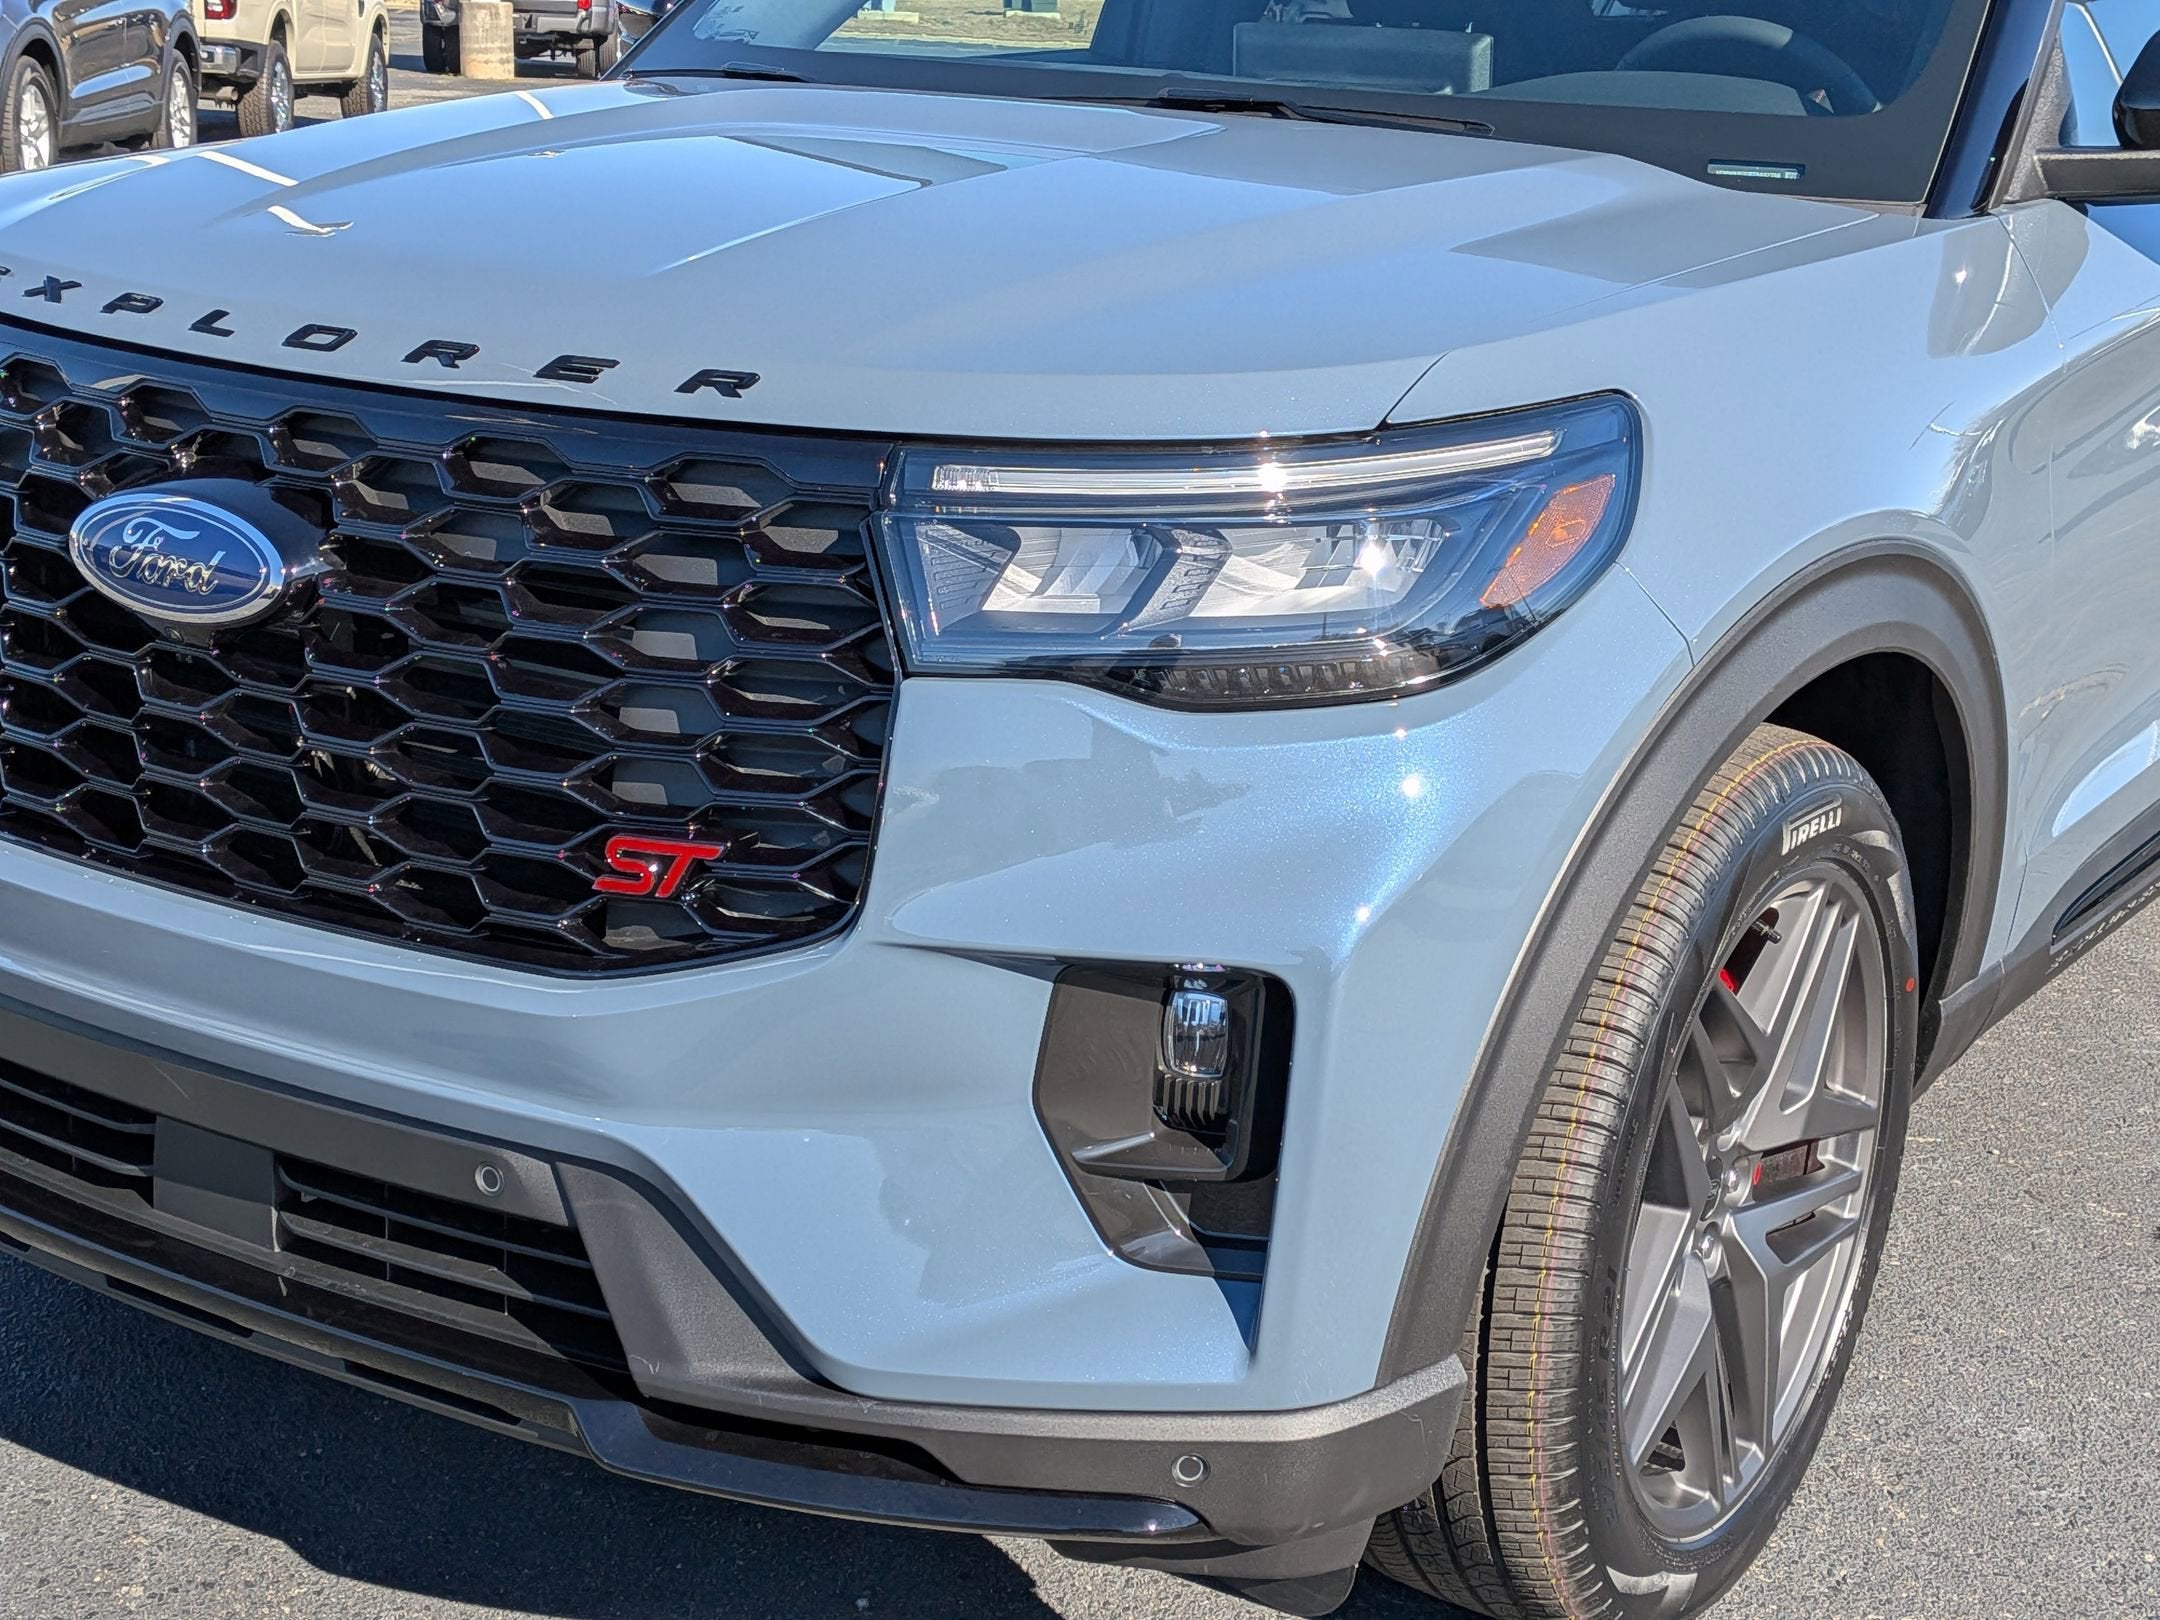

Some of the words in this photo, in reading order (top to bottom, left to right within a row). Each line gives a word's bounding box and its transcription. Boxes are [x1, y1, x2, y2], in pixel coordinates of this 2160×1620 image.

[0, 265, 762, 399] XPLORER
[108, 517, 226, 596] Ford
[1781, 793, 1843, 856] PIRELLI
[591, 834, 727, 898] ST
